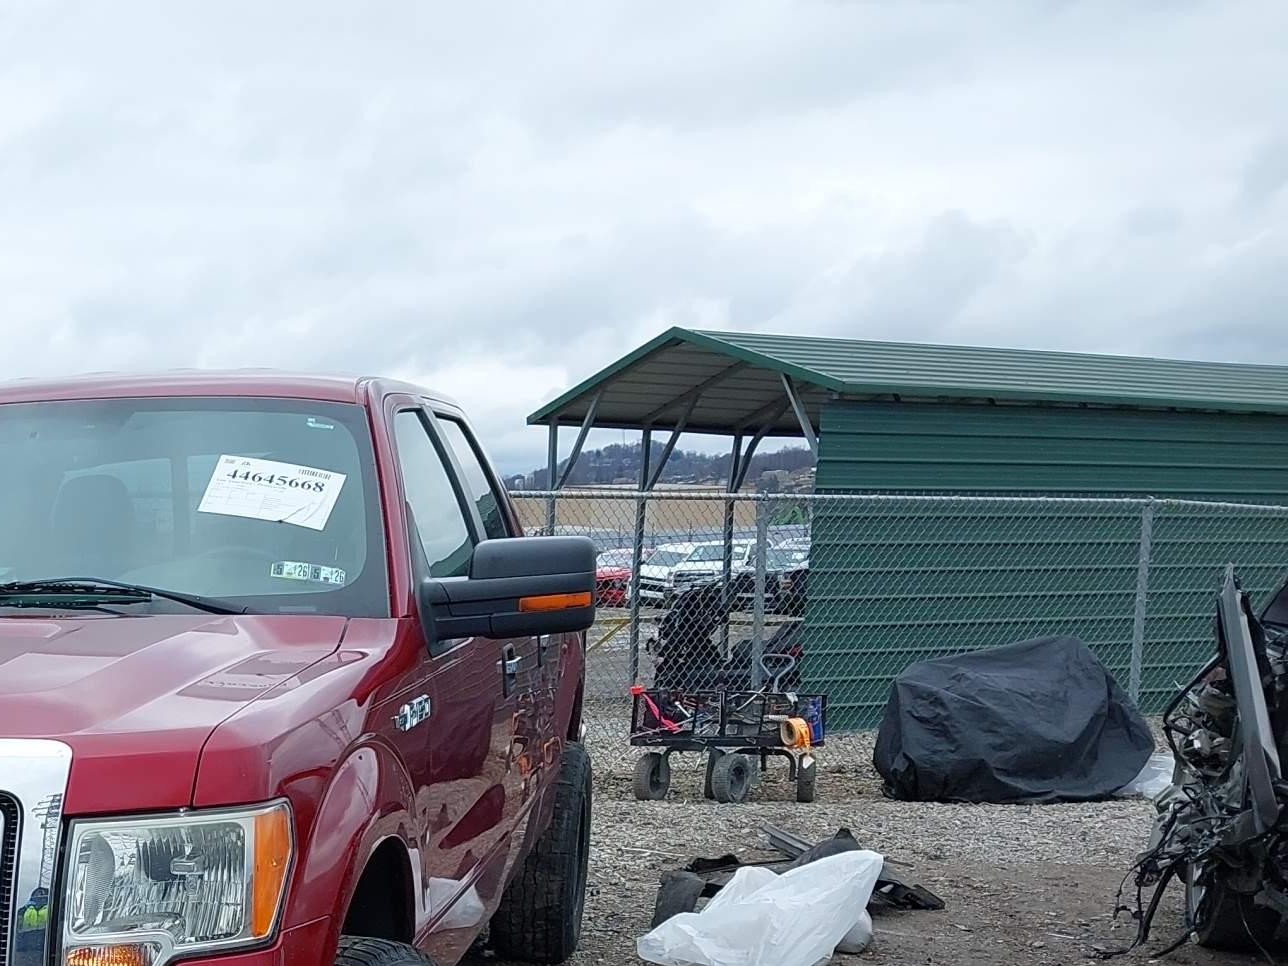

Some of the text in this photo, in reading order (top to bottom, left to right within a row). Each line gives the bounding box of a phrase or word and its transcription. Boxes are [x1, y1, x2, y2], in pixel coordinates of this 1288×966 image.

[226, 469, 325, 493] 44645668
[297, 564, 308, 577] 26
[334, 570, 344, 583] 26
